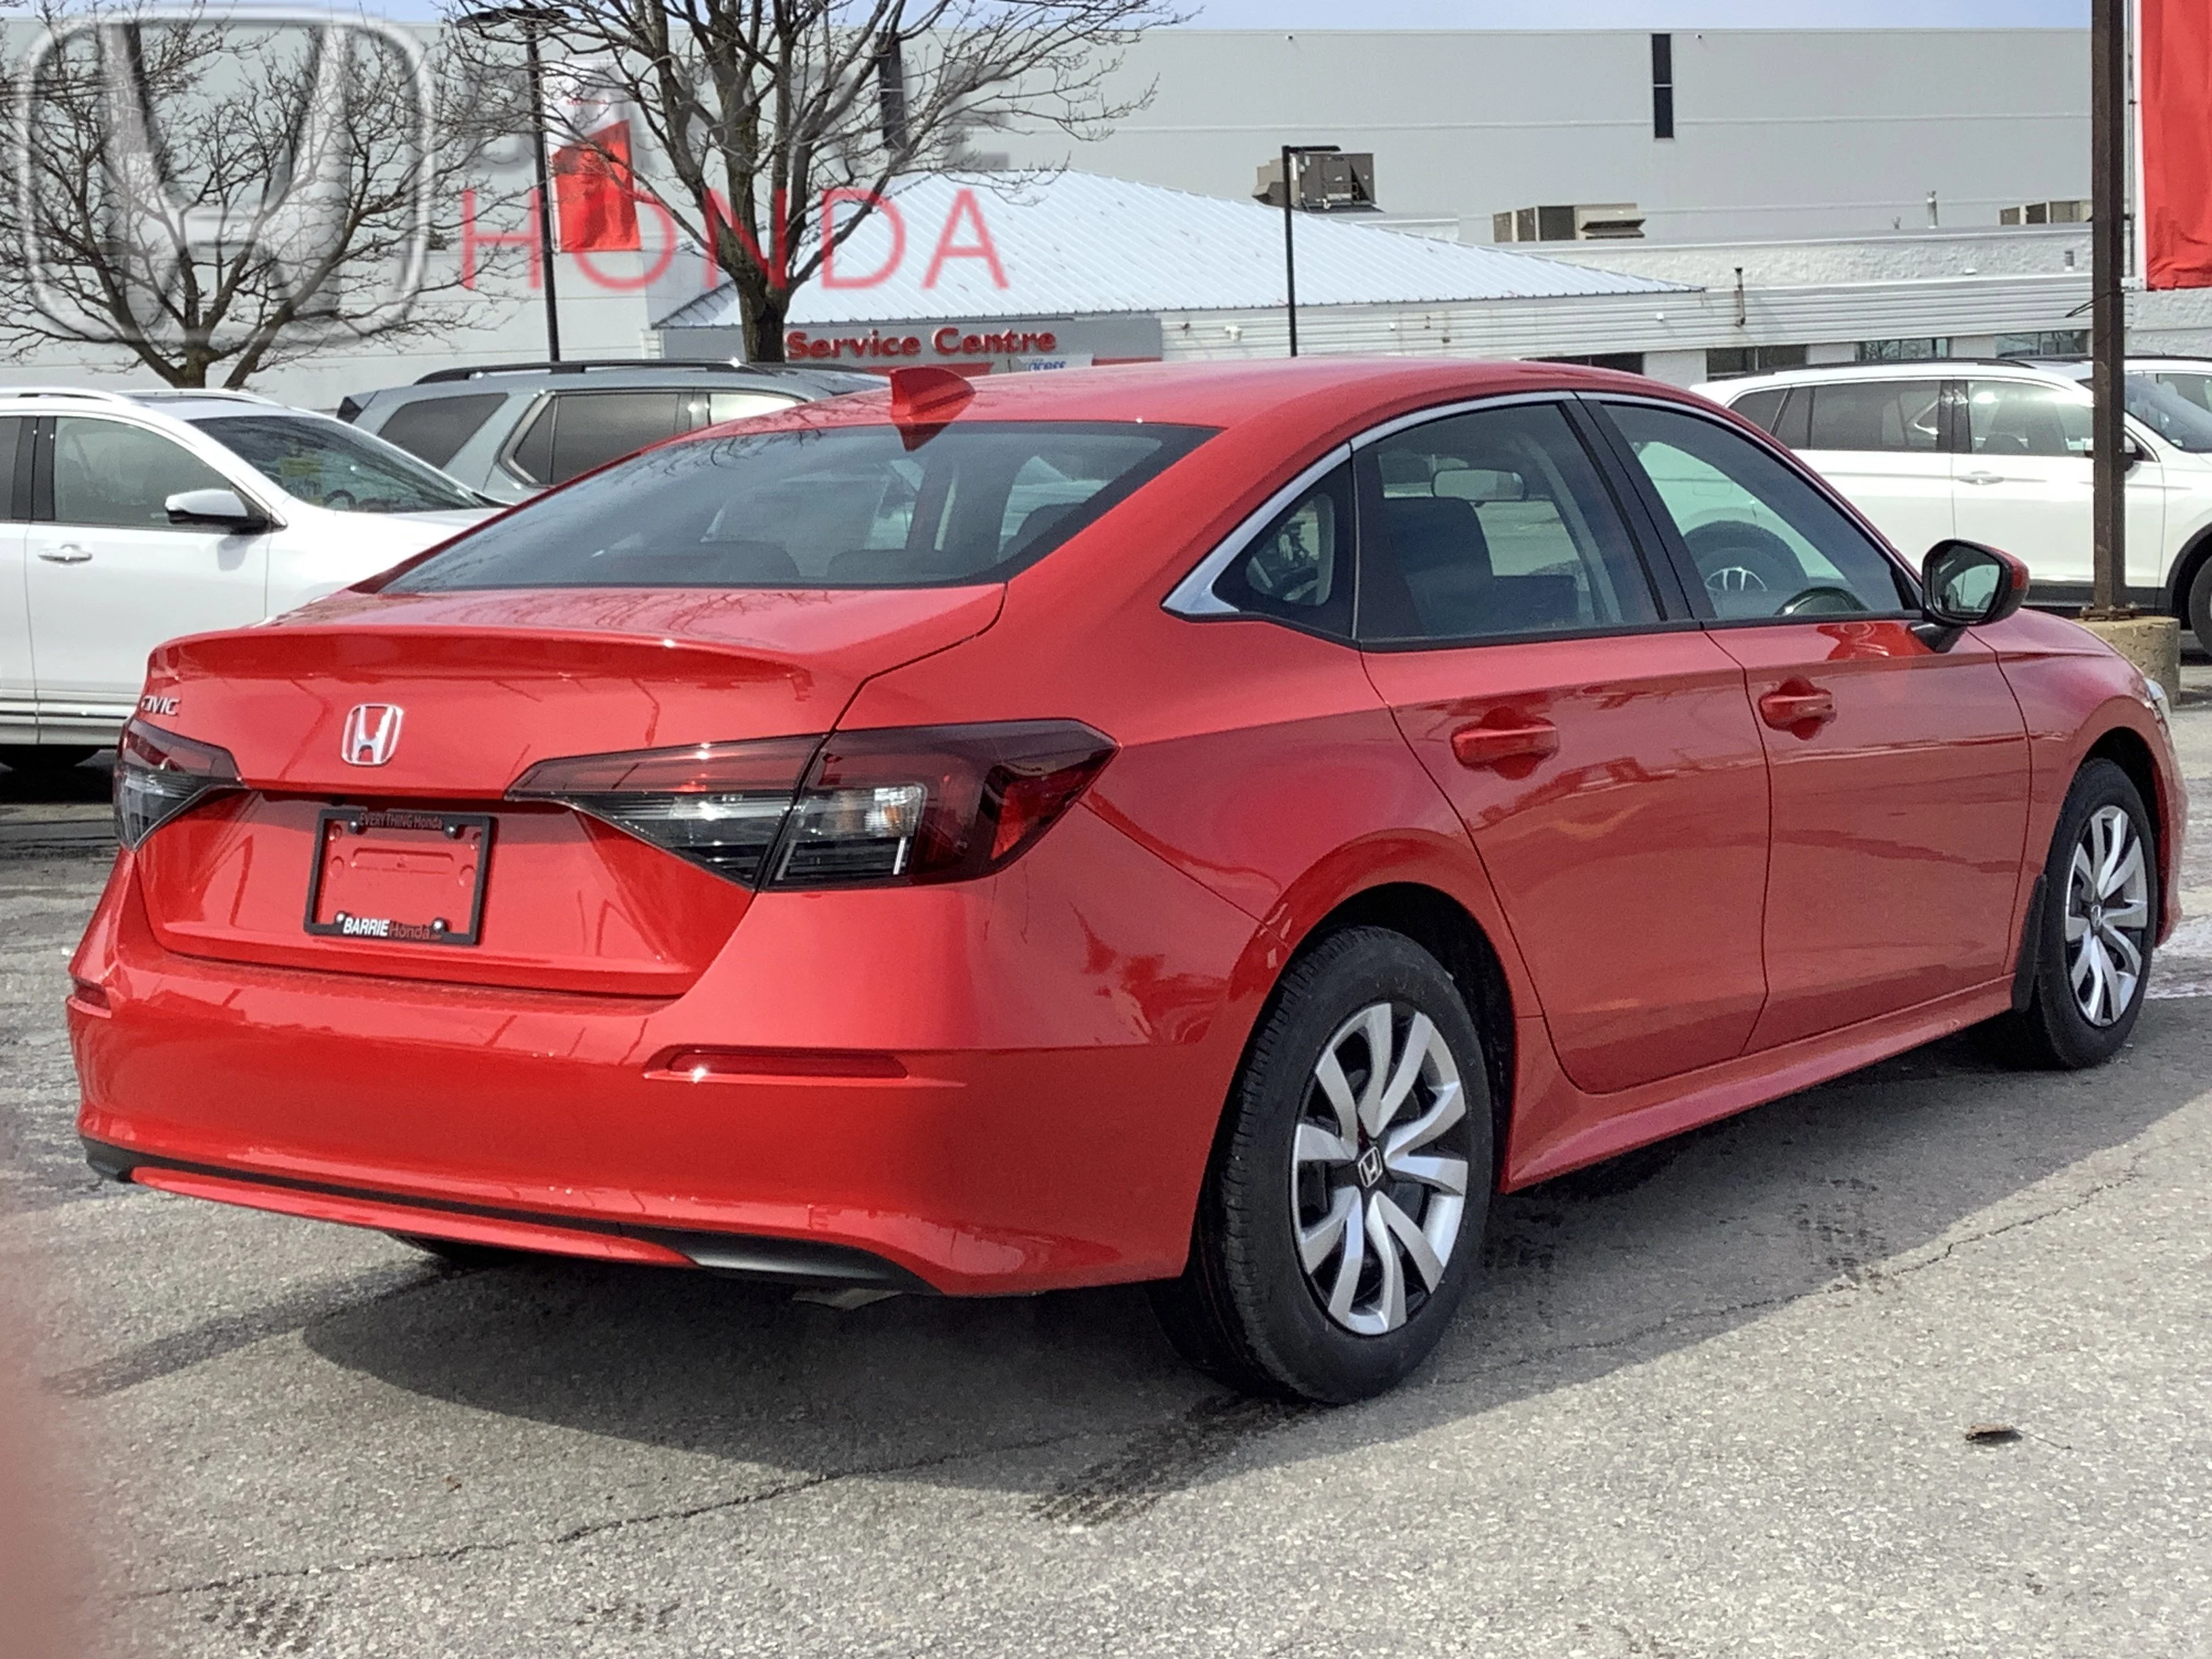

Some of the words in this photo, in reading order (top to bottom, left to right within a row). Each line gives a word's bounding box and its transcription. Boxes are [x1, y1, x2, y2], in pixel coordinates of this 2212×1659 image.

[786, 330, 921, 360] Service
[931, 327, 1057, 354] Centre
[141, 695, 180, 716] CIVIC
[343, 917, 391, 937] BARRIE
